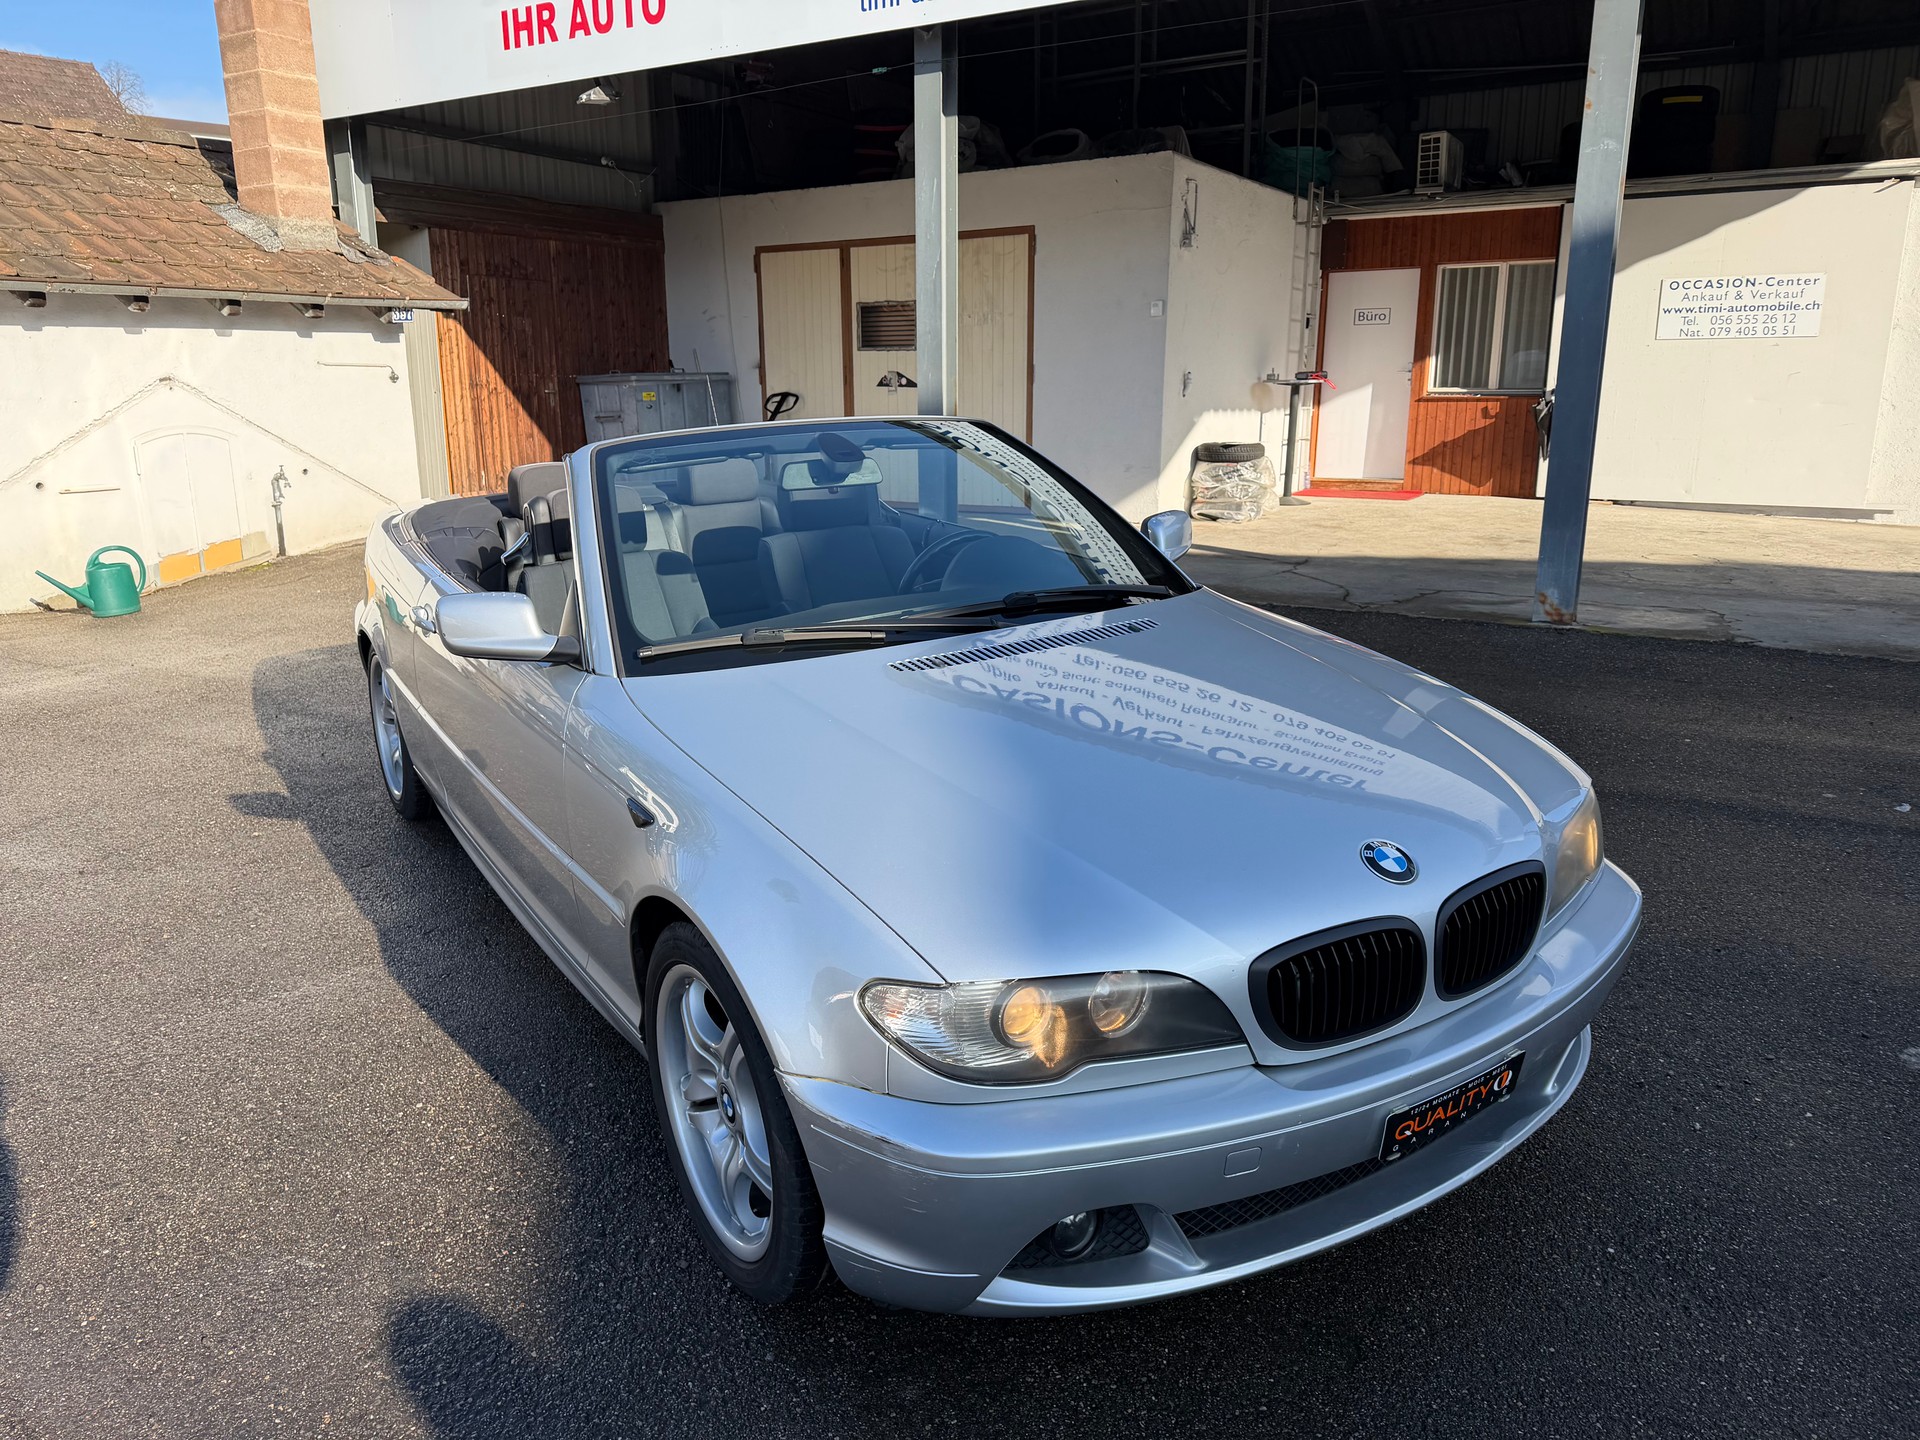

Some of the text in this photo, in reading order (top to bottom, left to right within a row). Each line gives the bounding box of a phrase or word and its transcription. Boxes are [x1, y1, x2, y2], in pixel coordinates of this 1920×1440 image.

[501, 2, 559, 50] IHR
[1669, 276, 1821, 291] OCCASION-Center
[1681, 288, 1806, 302] Ankauf & Verkauf
[1662, 301, 1821, 314] www.timi-automobile.ch
[1357, 311, 1387, 322] Büro
[1681, 313, 1797, 326] Tel. 056 555 26 12
[1679, 325, 1796, 337] Nat. 079 405 05 51
